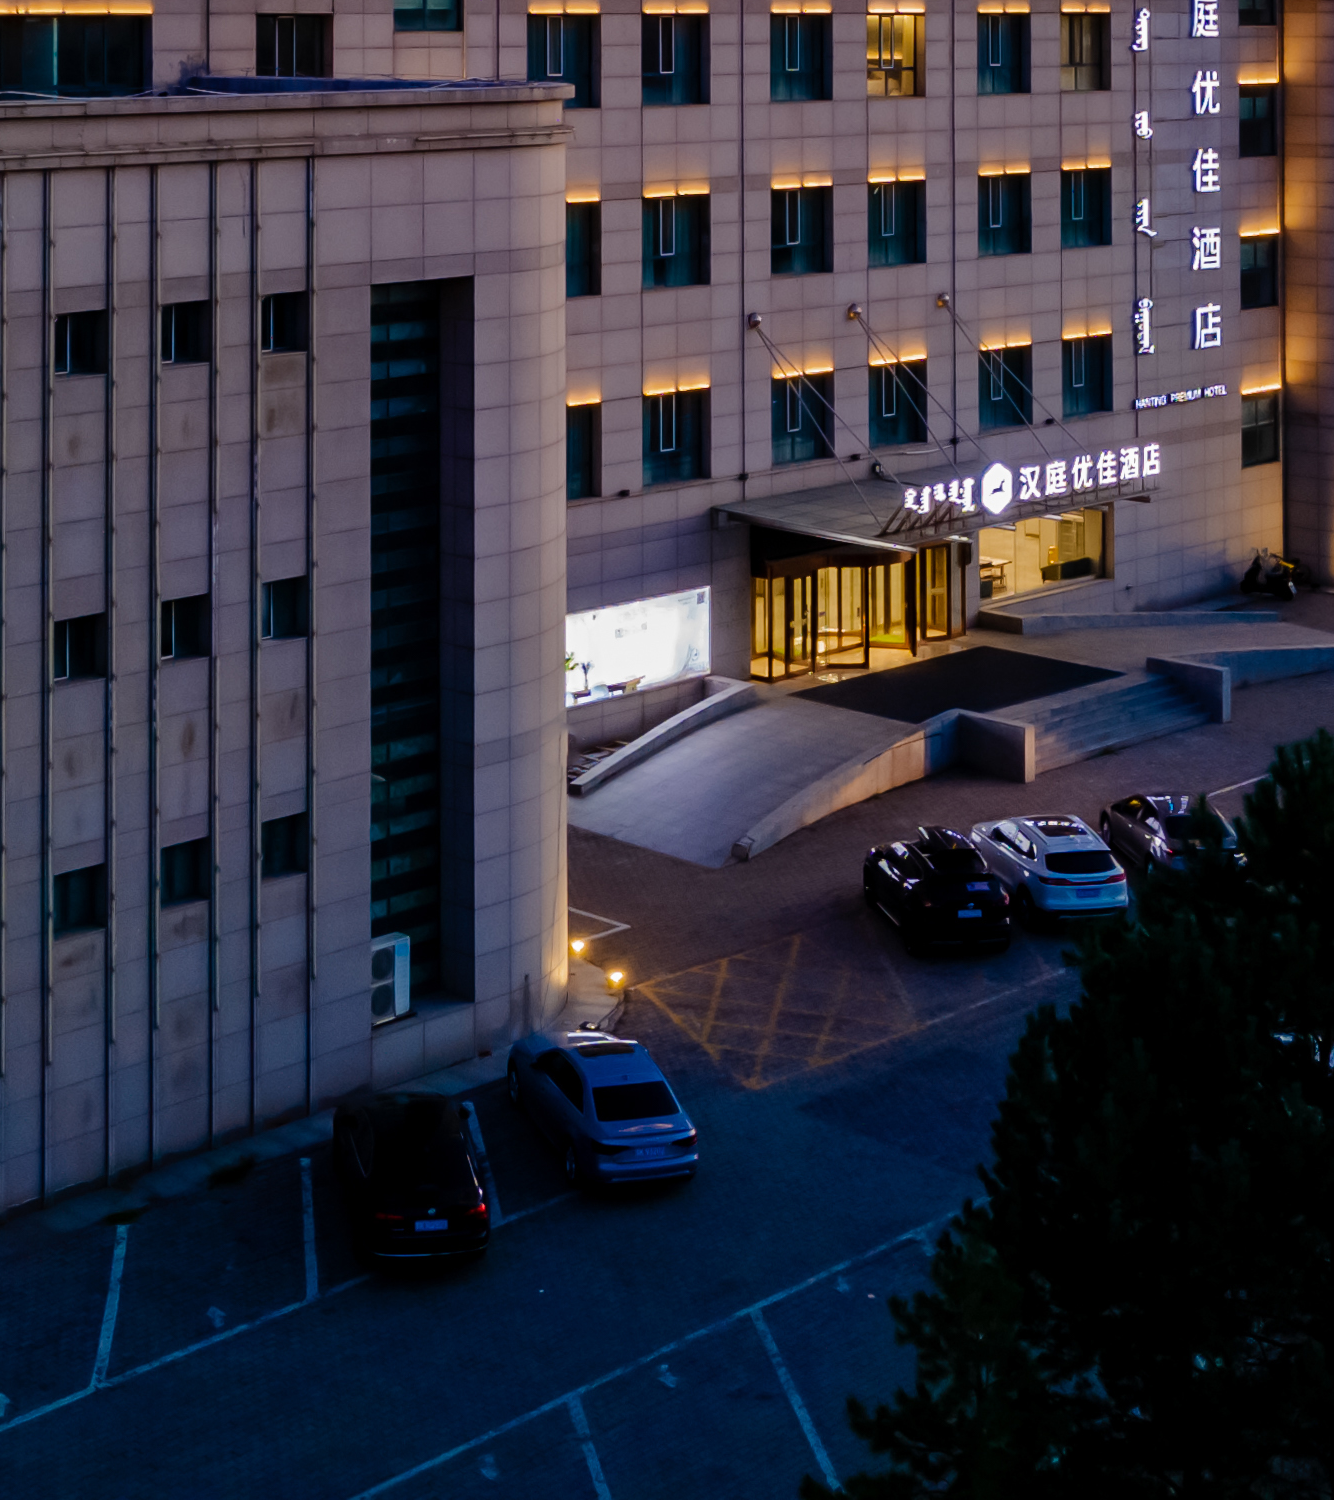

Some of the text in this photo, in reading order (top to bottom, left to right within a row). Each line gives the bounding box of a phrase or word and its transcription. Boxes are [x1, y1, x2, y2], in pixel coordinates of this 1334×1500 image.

[1204, 384, 1227, 397] HOTEL
[1019, 443, 1161, 501] 汉庭优佳酒店
